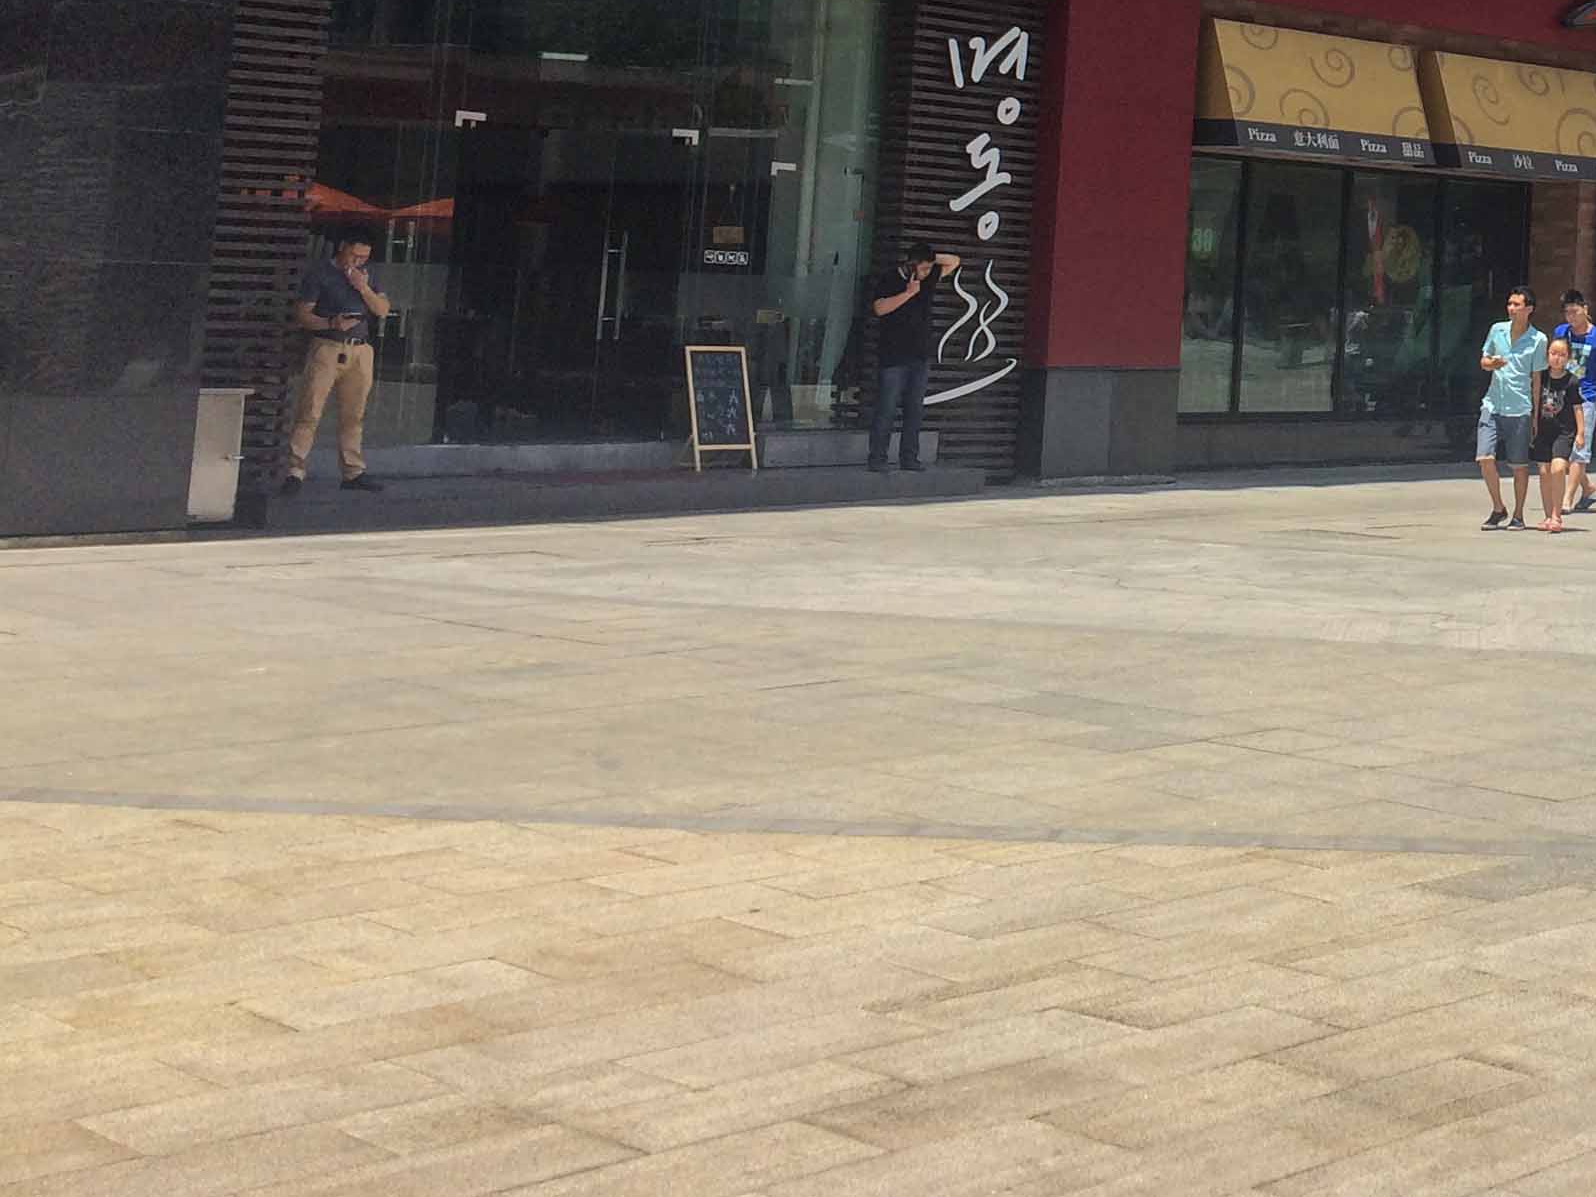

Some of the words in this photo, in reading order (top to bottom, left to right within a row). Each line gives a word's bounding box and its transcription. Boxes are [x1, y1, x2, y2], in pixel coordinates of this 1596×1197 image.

[1248, 127, 1278, 144] Pizza
[1293, 129, 1341, 151] 意大利面
[1360, 138, 1387, 154] Pizza
[1468, 150, 1493, 165] Pizza
[1555, 159, 1578, 173] Pizza
